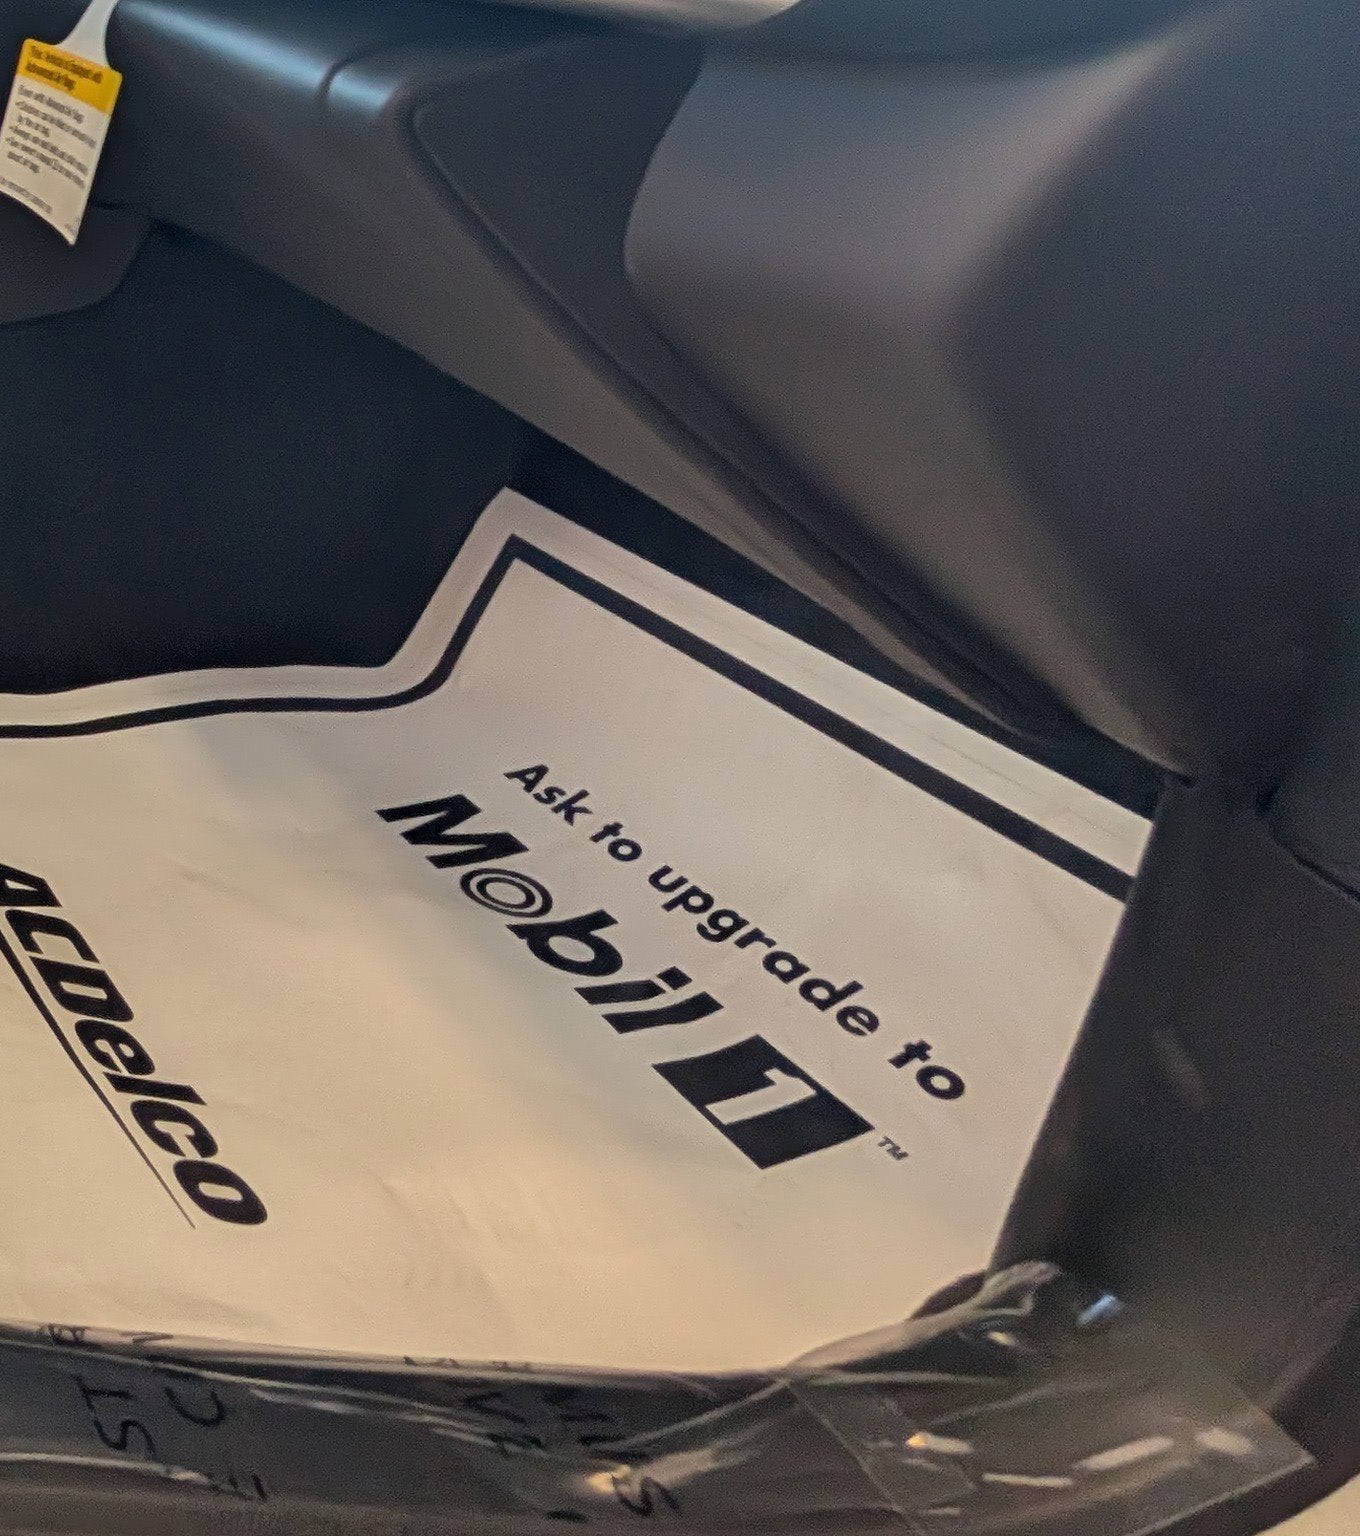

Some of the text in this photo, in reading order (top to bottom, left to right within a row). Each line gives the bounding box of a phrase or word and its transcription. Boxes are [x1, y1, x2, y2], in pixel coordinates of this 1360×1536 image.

[375, 793, 726, 1036] Mobil
[503, 763, 967, 1101] Ask to upgrade to
